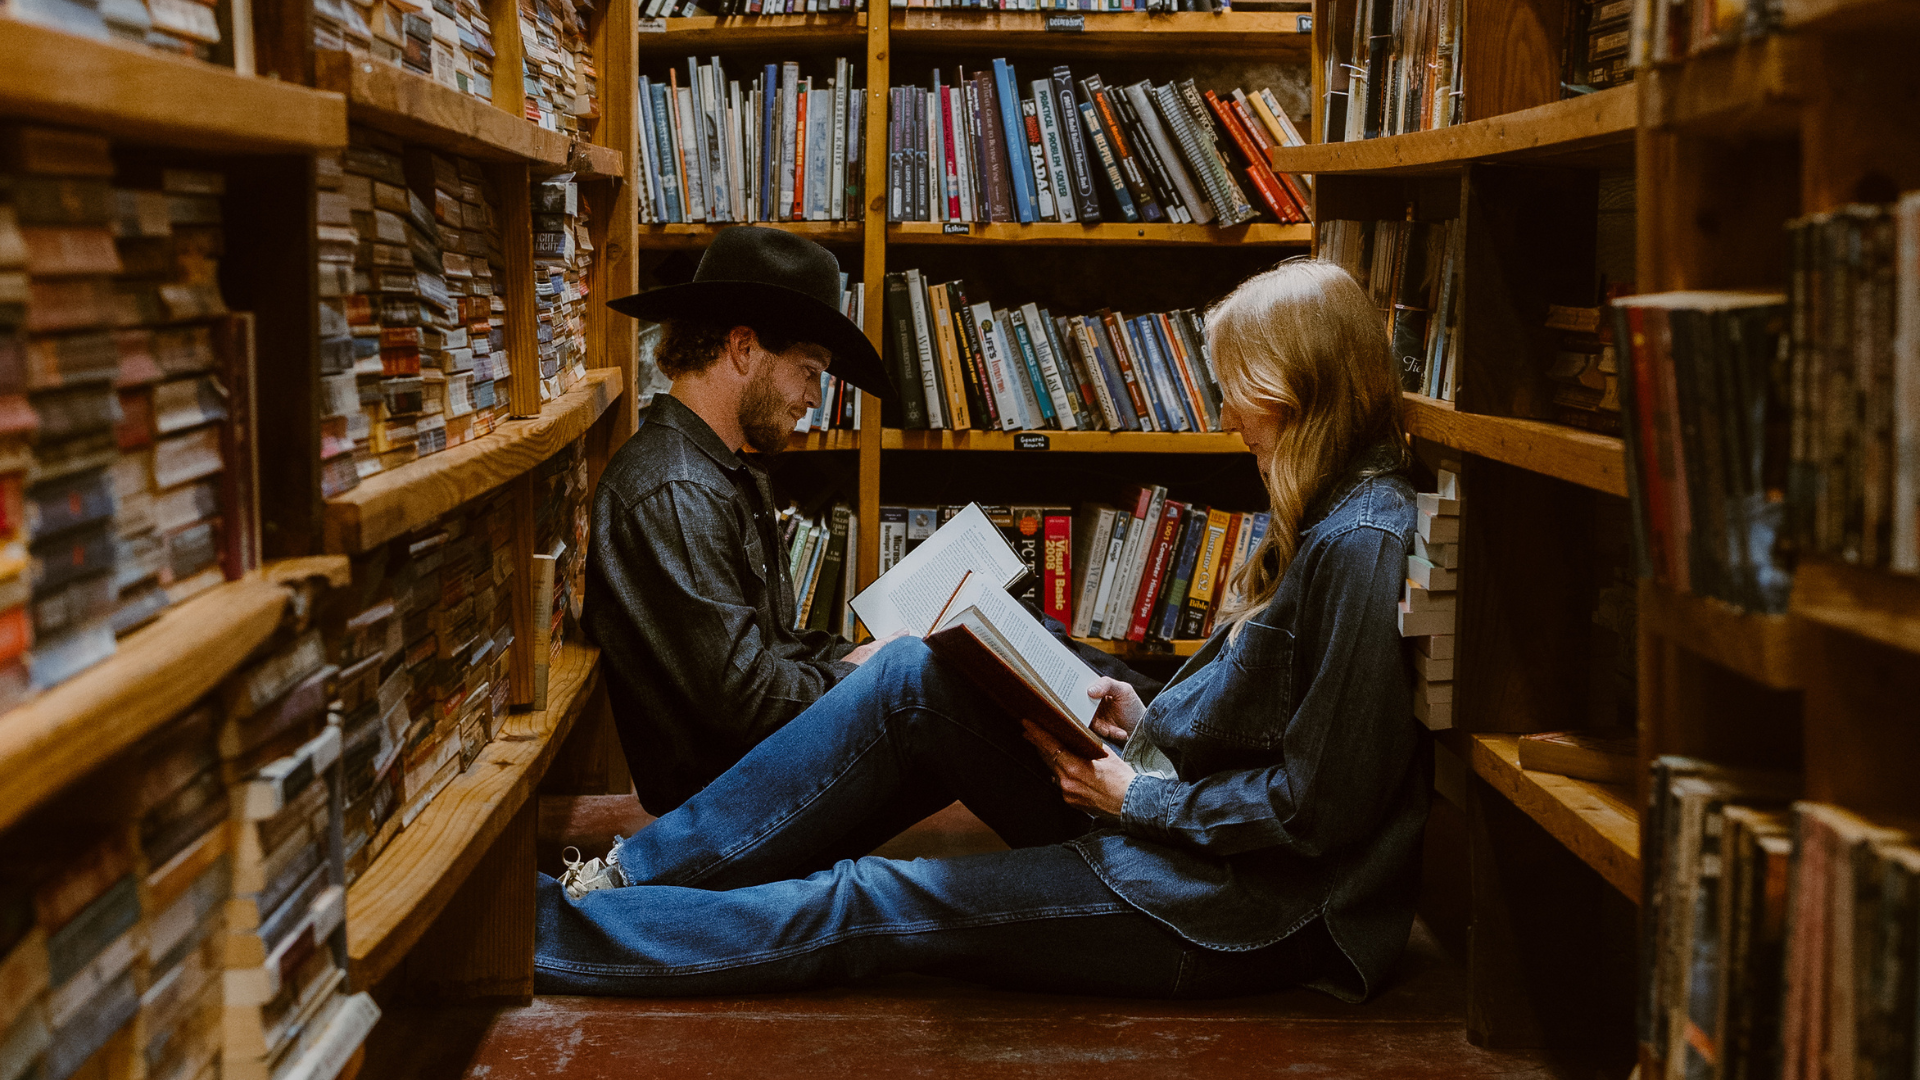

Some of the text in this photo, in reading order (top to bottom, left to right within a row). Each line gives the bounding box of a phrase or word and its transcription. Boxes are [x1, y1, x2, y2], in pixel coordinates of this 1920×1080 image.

[982, 77, 991, 107] ULTIMATE
[985, 108, 993, 129] GUIDE
[1095, 92, 1115, 126] Agricultural
[1110, 126, 1128, 158] Mechanics
[1183, 87, 1218, 144] HOW IT WORKS
[656, 100, 665, 118] THE
[663, 150, 672, 171] THE
[987, 130, 993, 139] TO
[1039, 90, 1068, 198] PRACTICAL PROBLEM SOLVER
[835, 137, 843, 166] KNITS
[987, 139, 996, 163] BUYING
[1094, 133, 1124, 190] HELPFUL HINTS
[991, 164, 999, 183] WINE
[1079, 177, 1088, 189] Book
[945, 224, 969, 233] Fashion
[960, 296, 967, 305] RV
[963, 306, 978, 353] HANDBOOK
[983, 329, 997, 359] LIFE'S
[1141, 320, 1159, 364] PARACHUTING
[955, 312, 968, 348] BOOKKEEPING
[966, 358, 974, 372] EASY
[970, 372, 978, 384] WAY
[1018, 328, 1036, 366] eBay HACKS
[917, 335, 929, 366] WILL
[923, 370, 934, 390] KIT
[1035, 341, 1049, 364] Make
[1045, 372, 1060, 392] Last
[1205, 359, 1217, 384] Comfort
[883, 525, 891, 557] Developer's
[1045, 540, 1055, 570] 2008
[1097, 530, 1109, 566] MAINTAINING
[1110, 542, 1120, 562] Google
[1125, 538, 1137, 566] TECHNOLOGY
[1022, 540, 1035, 598] PC TH
[1055, 540, 1066, 575] Visual
[1153, 542, 1169, 578] Computer
[1198, 525, 1226, 592] Illustrator CS2
[1055, 579, 1066, 610] Basic
[1085, 566, 1100, 594] VCRs
[1115, 574, 1127, 600] AUTOMATED
[1147, 578, 1158, 598] Hints
[1141, 602, 1152, 618] Tips
[1189, 599, 1208, 610] Bible
[1106, 615, 1116, 635] CONTROL
